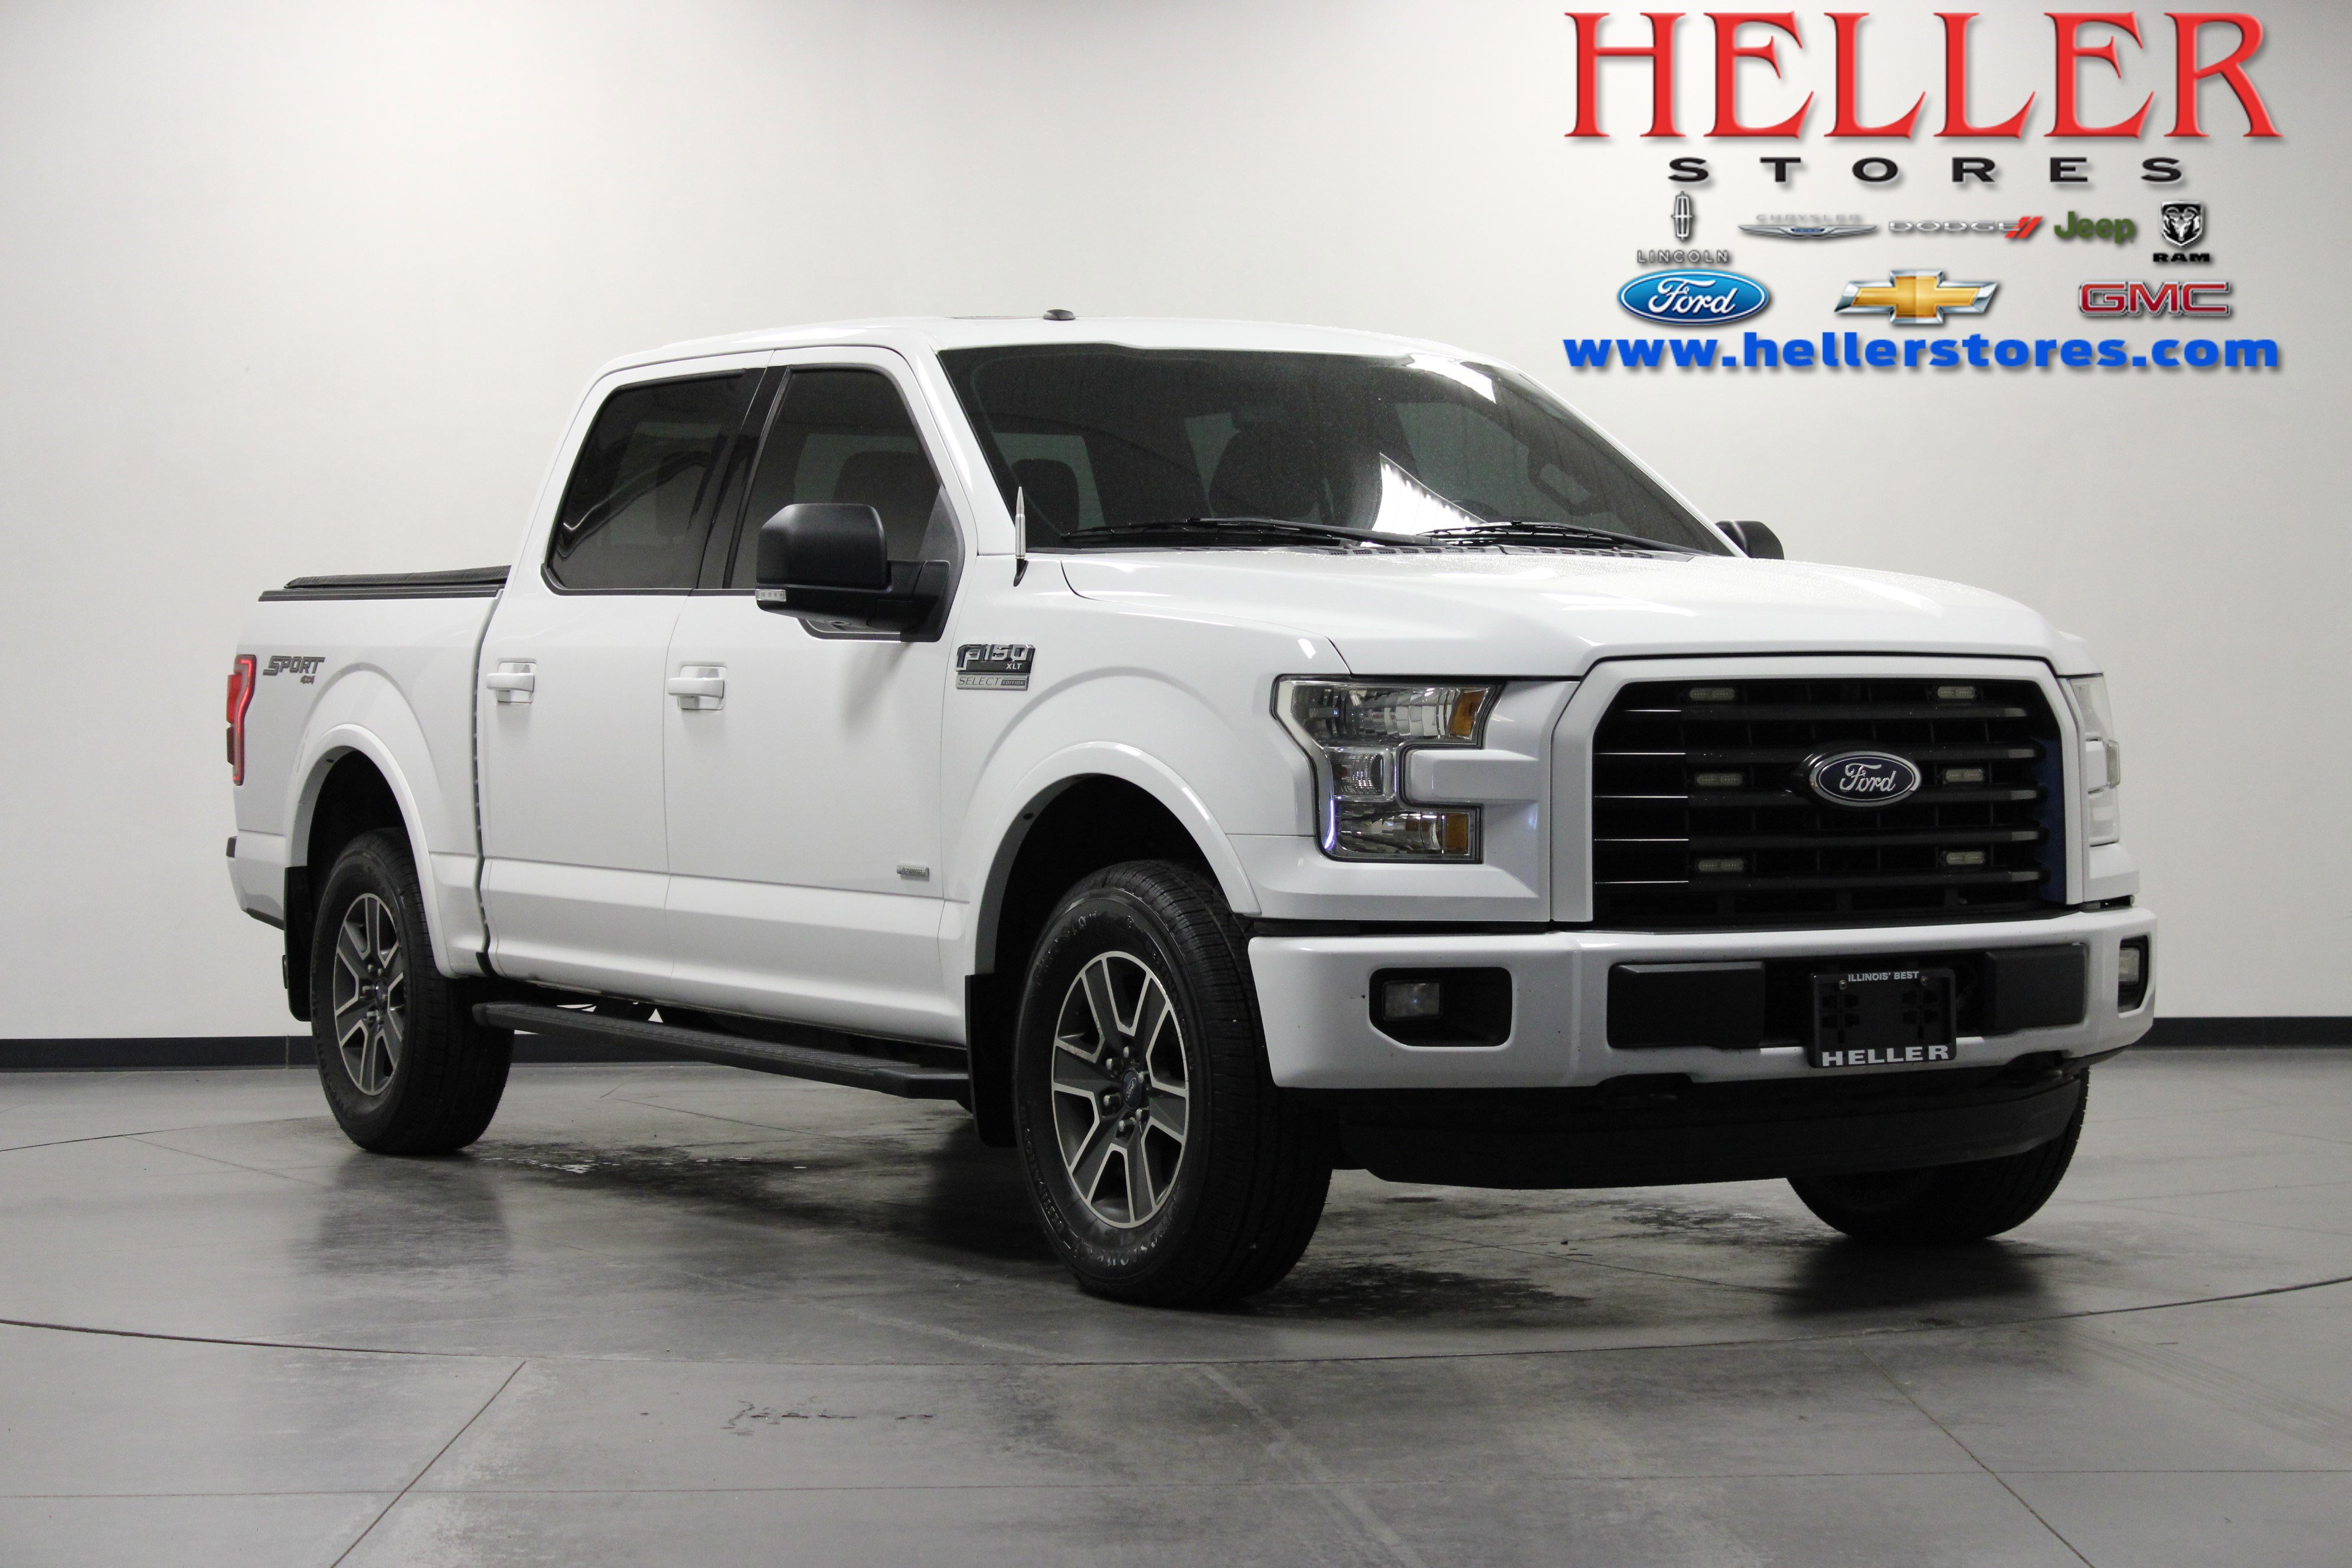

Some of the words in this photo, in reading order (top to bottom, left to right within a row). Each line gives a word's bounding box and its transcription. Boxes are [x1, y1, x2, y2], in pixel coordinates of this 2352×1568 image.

[262, 655, 325, 676] SPORT
[958, 677, 1001, 686] SELECT
[1838, 762, 1897, 792] Ford
[1848, 972, 1891, 982] ILLINOIS'
[1893, 971, 1919, 980] BEST
[1822, 1044, 1949, 1067] HELLER
